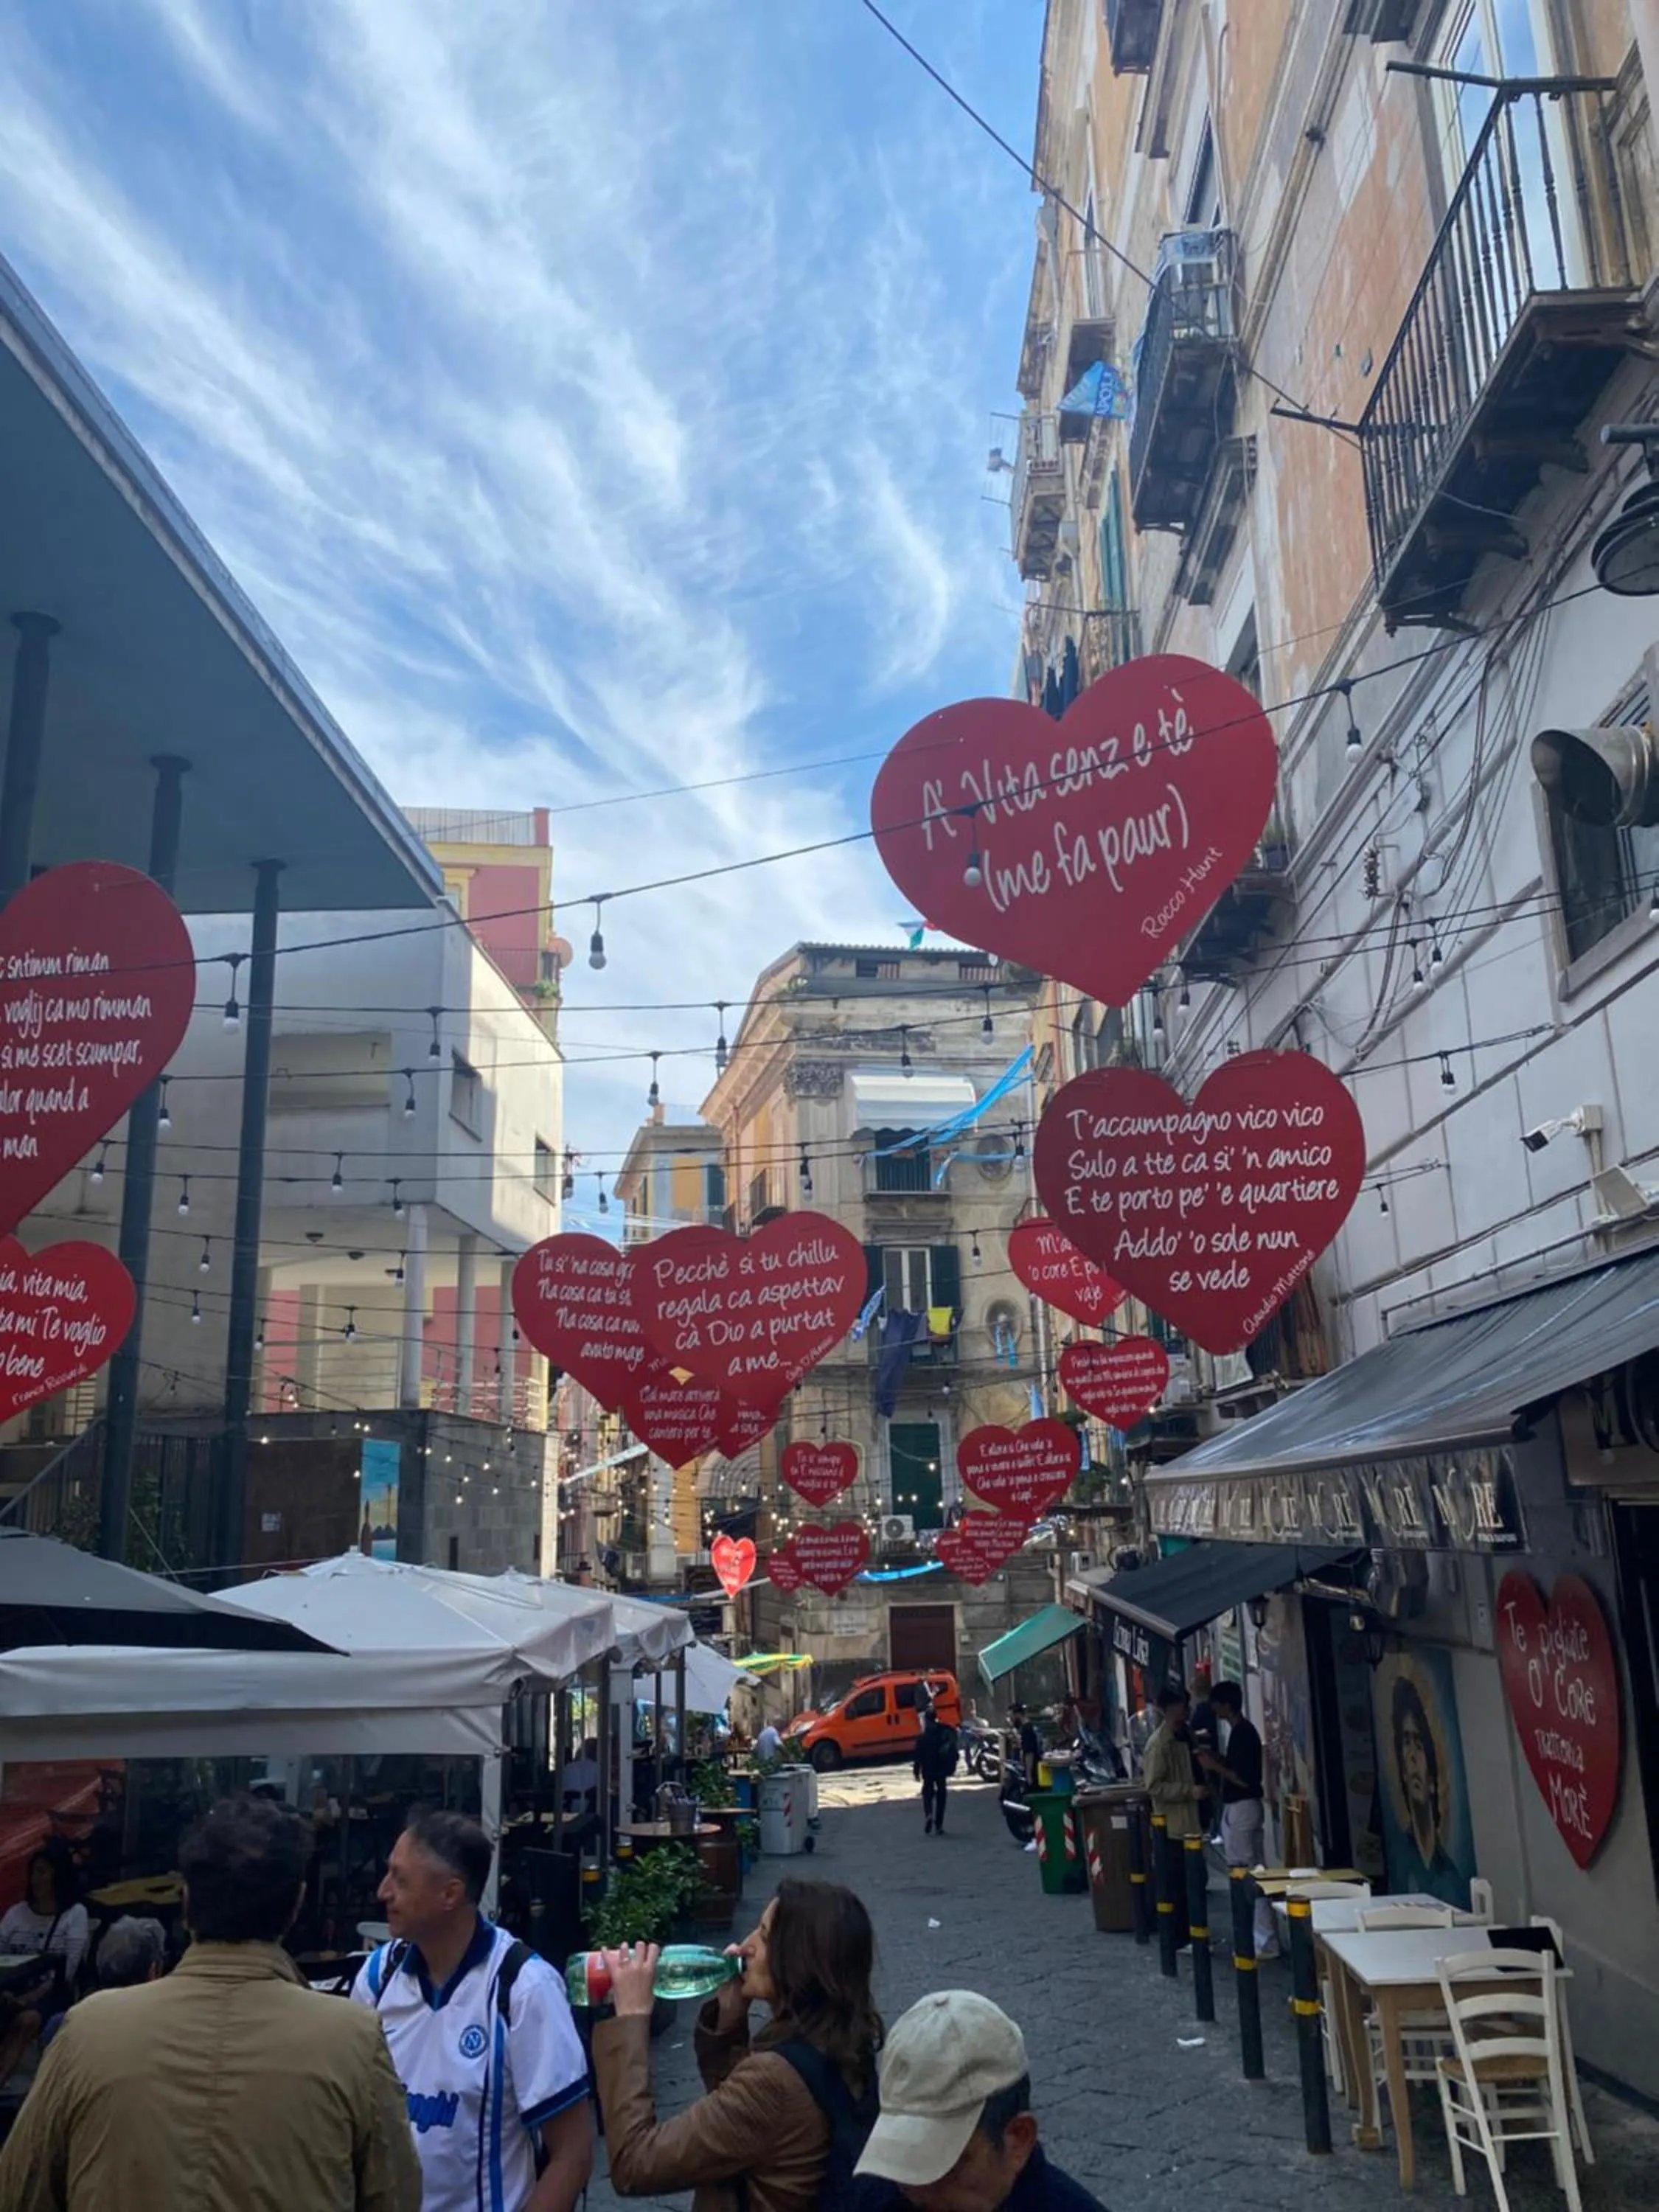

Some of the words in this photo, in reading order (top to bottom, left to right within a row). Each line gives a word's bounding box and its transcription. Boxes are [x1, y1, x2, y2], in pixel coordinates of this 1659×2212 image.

[961, 759, 1046, 824] Vita
[1051, 737, 1129, 796] senz
[1054, 821, 1096, 886] fa
[1099, 783, 1189, 893] paur)
[1141, 890, 1186, 939] Rocco
[1179, 847, 1223, 894] Hunt
[1066, 1108, 1232, 1145] T'accumpagno
[1237, 1105, 1278, 1130] vico
[1283, 1102, 1325, 1128] vico
[1068, 1149, 1117, 1181] Sulo
[1122, 1155, 1138, 1176] a
[1144, 1152, 1177, 1175] tte
[1181, 1151, 1208, 1174] ca
[1267, 1141, 1333, 1168] amico
[1065, 1186, 1085, 1215] E
[1091, 1188, 1113, 1211] te
[1119, 1183, 1174, 1222] porto
[1239, 1174, 1339, 1215] quartiere
[1211, 1222, 1252, 1253] sole
[1257, 1228, 1301, 1251] nun
[653, 1252, 730, 1288] Pecchè
[739, 1252, 755, 1276] si
[759, 1252, 782, 1273] tu
[787, 1238, 840, 1267] chillu
[1169, 1267, 1194, 1293] se
[1197, 1258, 1251, 1292] vede
[656, 1289, 723, 1328] regala
[727, 1289, 753, 1310] ca
[758, 1276, 845, 1310] aspettav
[1242, 1294, 1278, 1335] Claudio
[1272, 1249, 1315, 1296] Mattone
[41, 1306, 62, 1340] Te
[64, 1313, 107, 1357] voglio
[706, 1319, 745, 1346] Dio
[749, 1320, 765, 1340] a
[769, 1307, 836, 1345] purtat
[727, 1355, 742, 1377] a
[1503, 1601, 1528, 1652] Te
